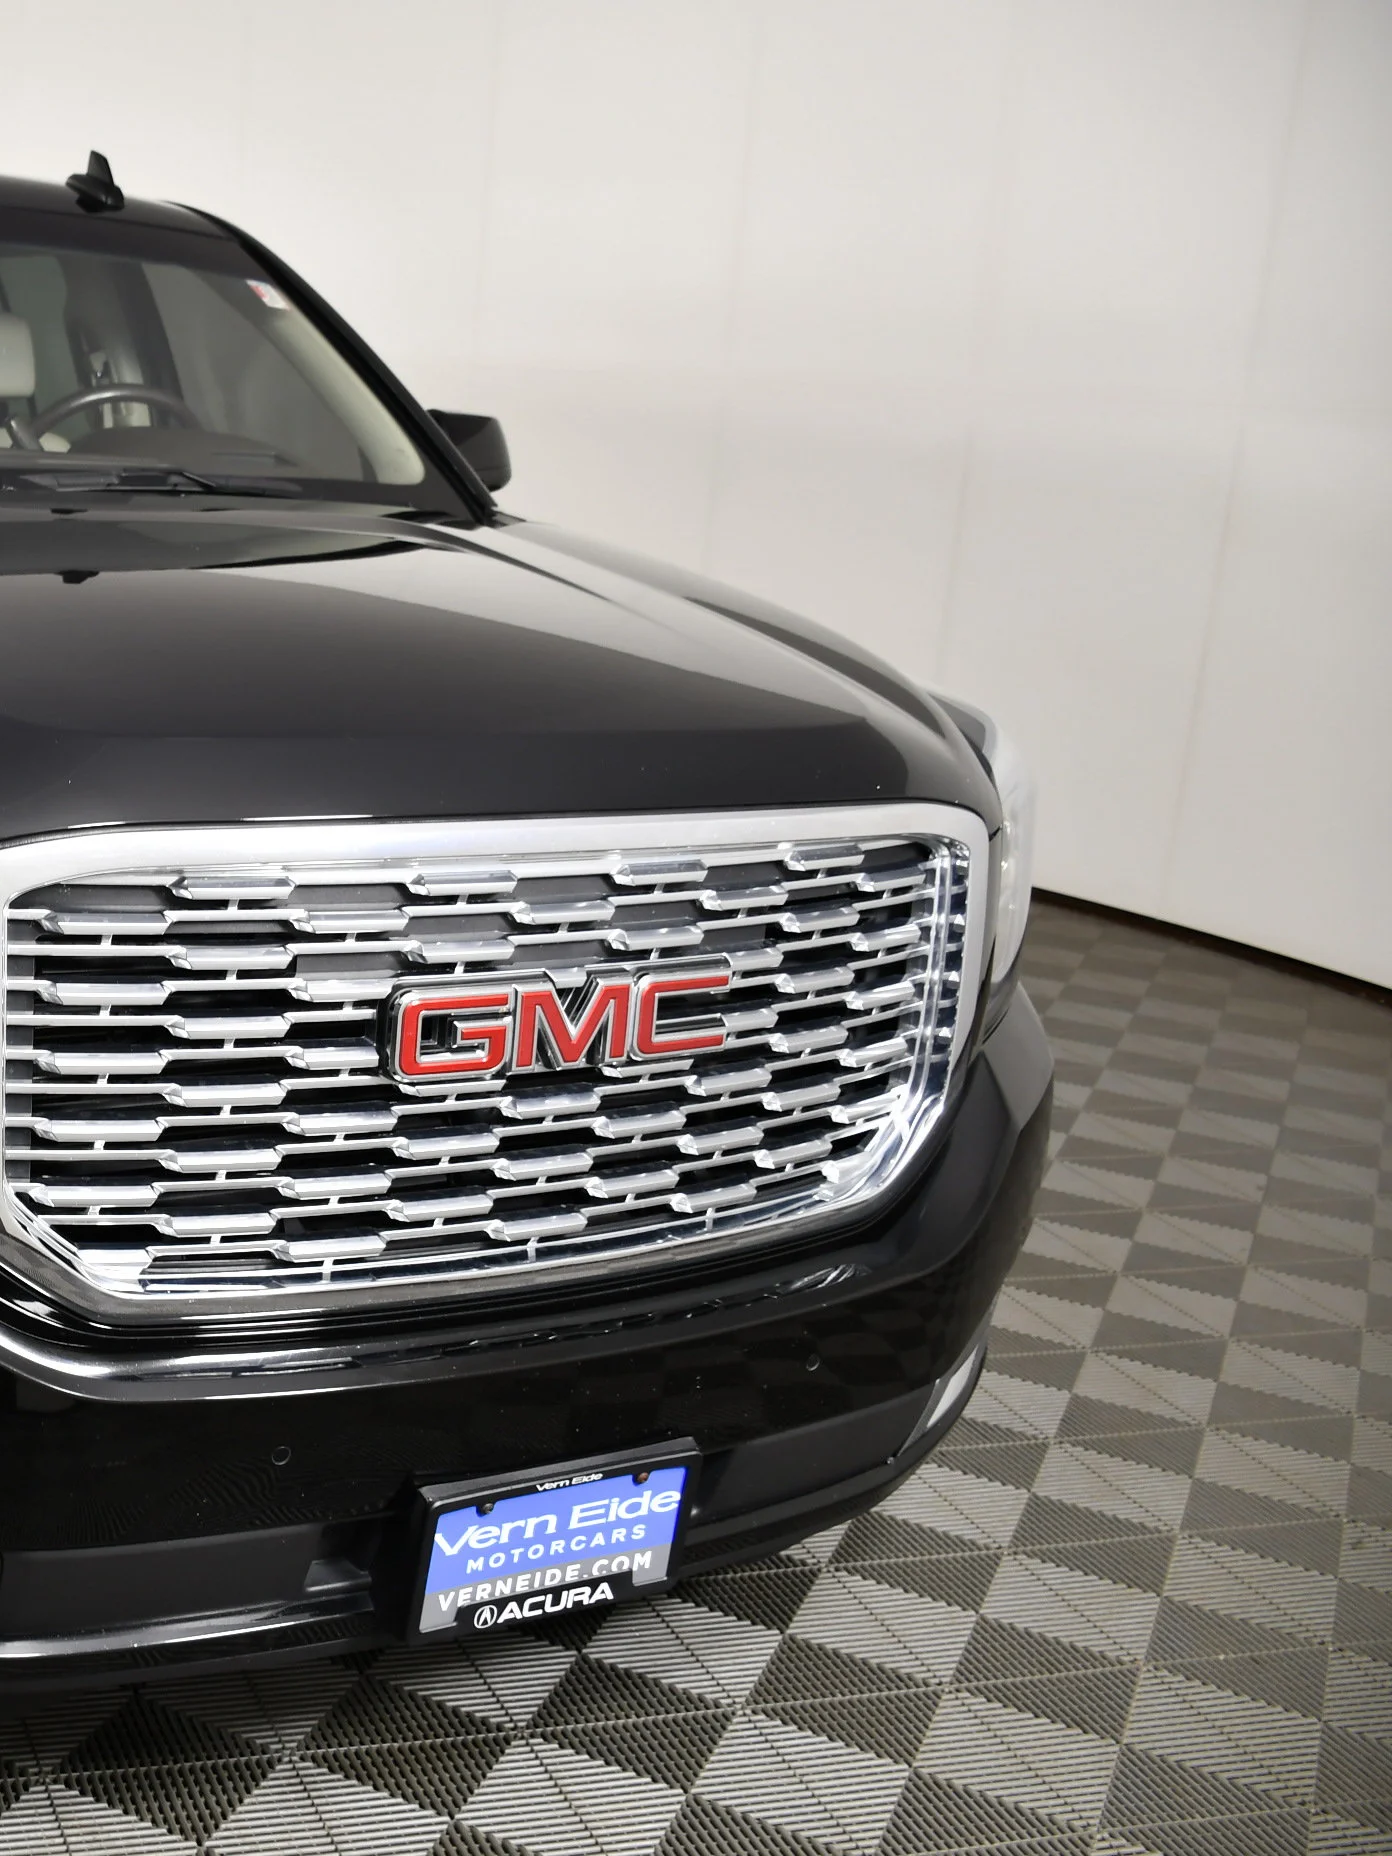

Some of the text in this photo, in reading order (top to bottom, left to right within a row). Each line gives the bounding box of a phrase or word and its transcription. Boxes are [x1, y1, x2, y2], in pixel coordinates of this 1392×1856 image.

[397, 972, 731, 1079] GMC
[535, 1473, 603, 1491] Vern Eide
[434, 1489, 681, 1557] Vern Eide
[466, 1524, 646, 1574] MOTORCARS
[438, 1550, 652, 1612] VERNEIDE.COM
[497, 1582, 614, 1623] ACURA
